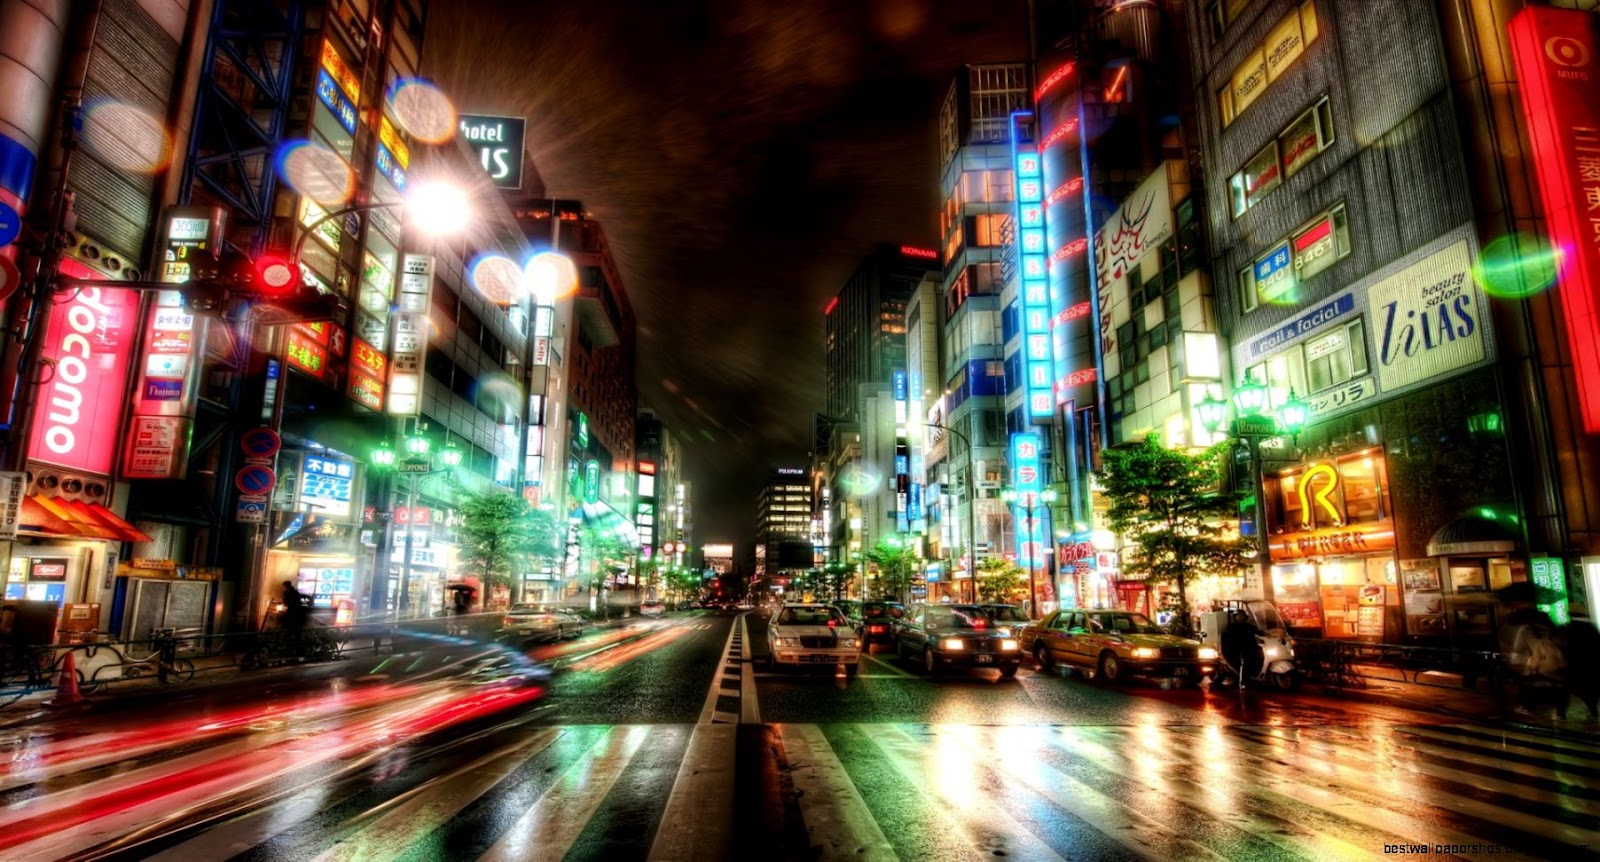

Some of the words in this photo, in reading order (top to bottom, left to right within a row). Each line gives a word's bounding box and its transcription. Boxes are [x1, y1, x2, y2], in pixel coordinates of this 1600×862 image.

[1557, 70, 1588, 81] MUFG
[460, 121, 503, 142] hotel
[901, 246, 937, 258] KONAMI
[1421, 271, 1465, 299] beauty
[1425, 286, 1462, 309] salon
[1260, 330, 1285, 352] nail
[1287, 328, 1296, 339] &
[1297, 302, 1341, 333] facial
[45, 281, 111, 454] docomo
[357, 344, 384, 370] エステ
[1333, 384, 1364, 406] リラ
[1298, 464, 1341, 527] R
[396, 535, 423, 543] DRGS
[1297, 531, 1368, 554] BURGER
